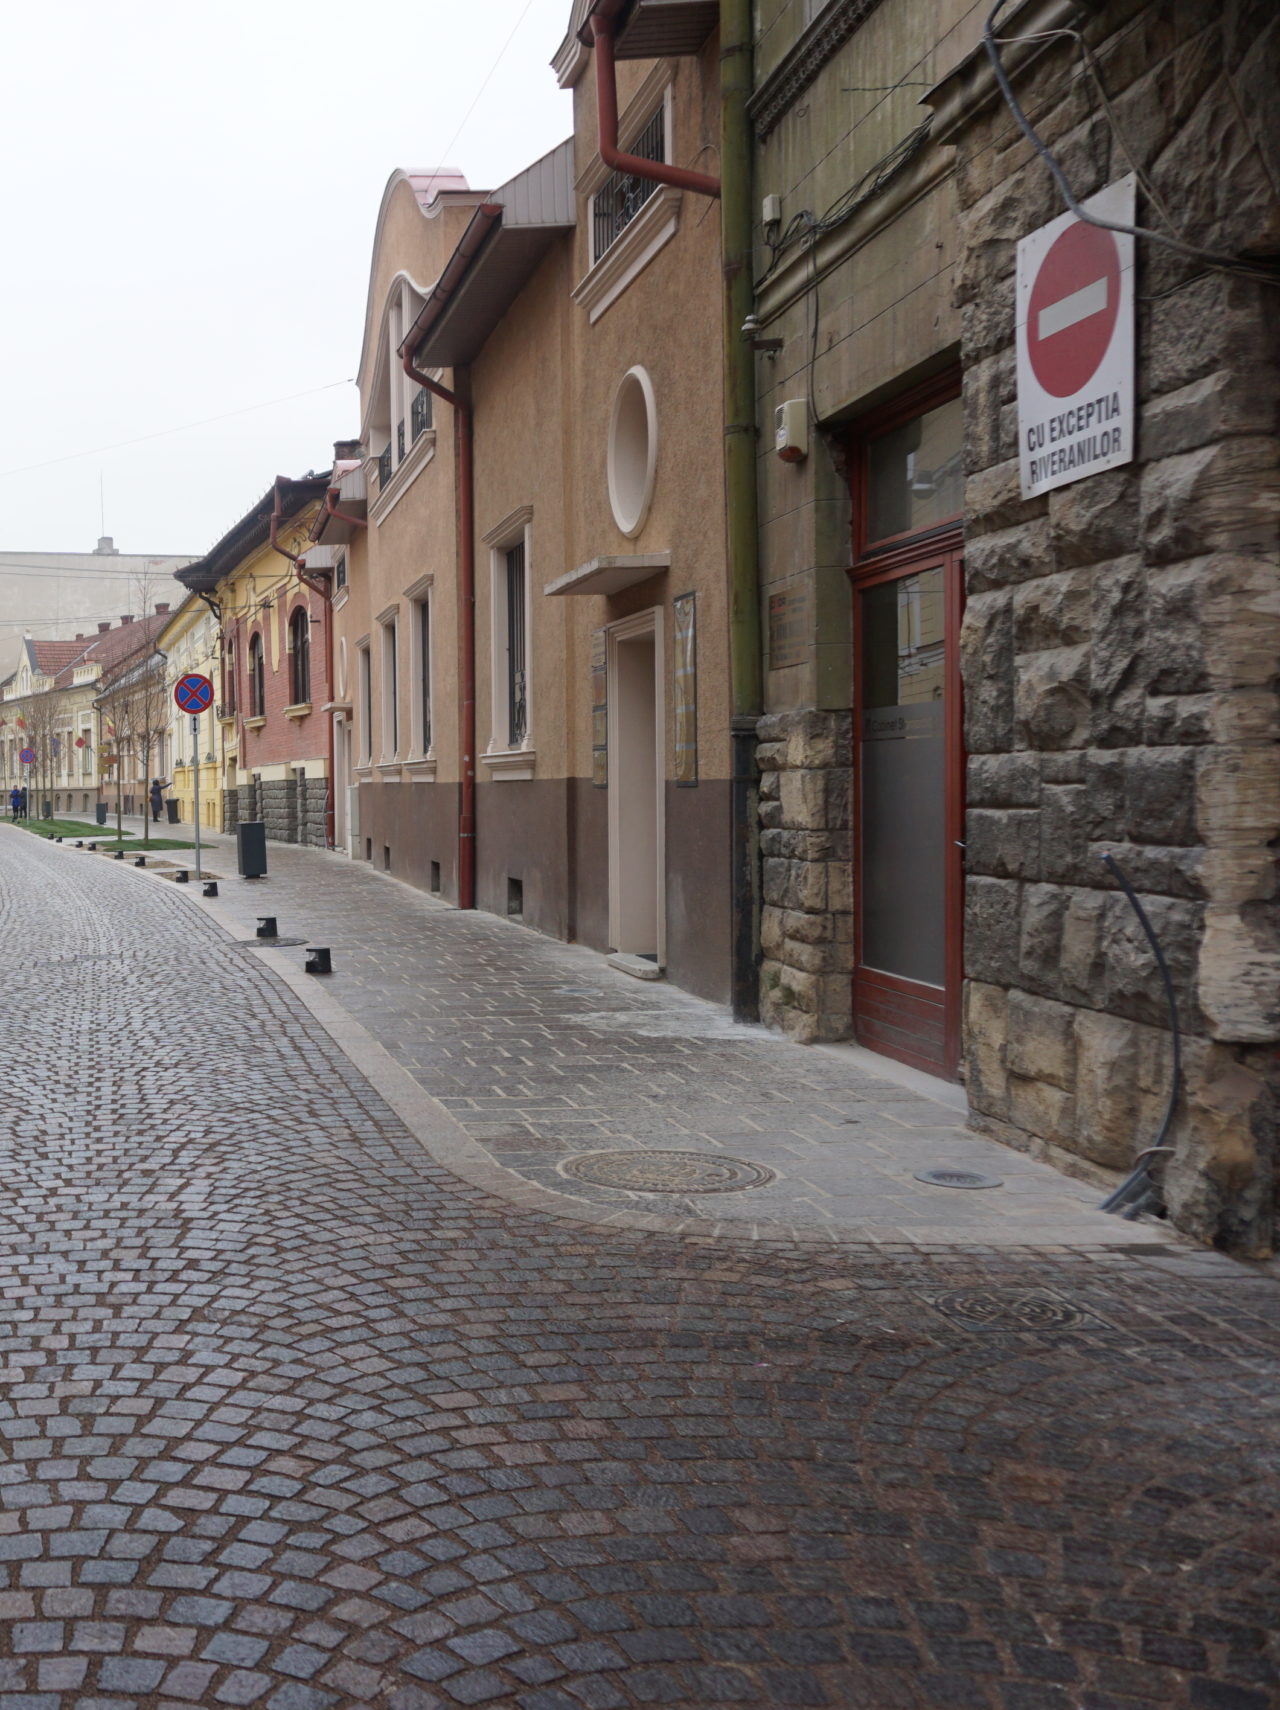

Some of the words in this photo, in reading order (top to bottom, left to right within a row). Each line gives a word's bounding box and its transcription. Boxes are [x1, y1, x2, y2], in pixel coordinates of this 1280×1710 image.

[1027, 423, 1044, 451] CU
[1049, 391, 1121, 443] EXCEPTIA
[1030, 426, 1122, 484] RIVERANILOR
